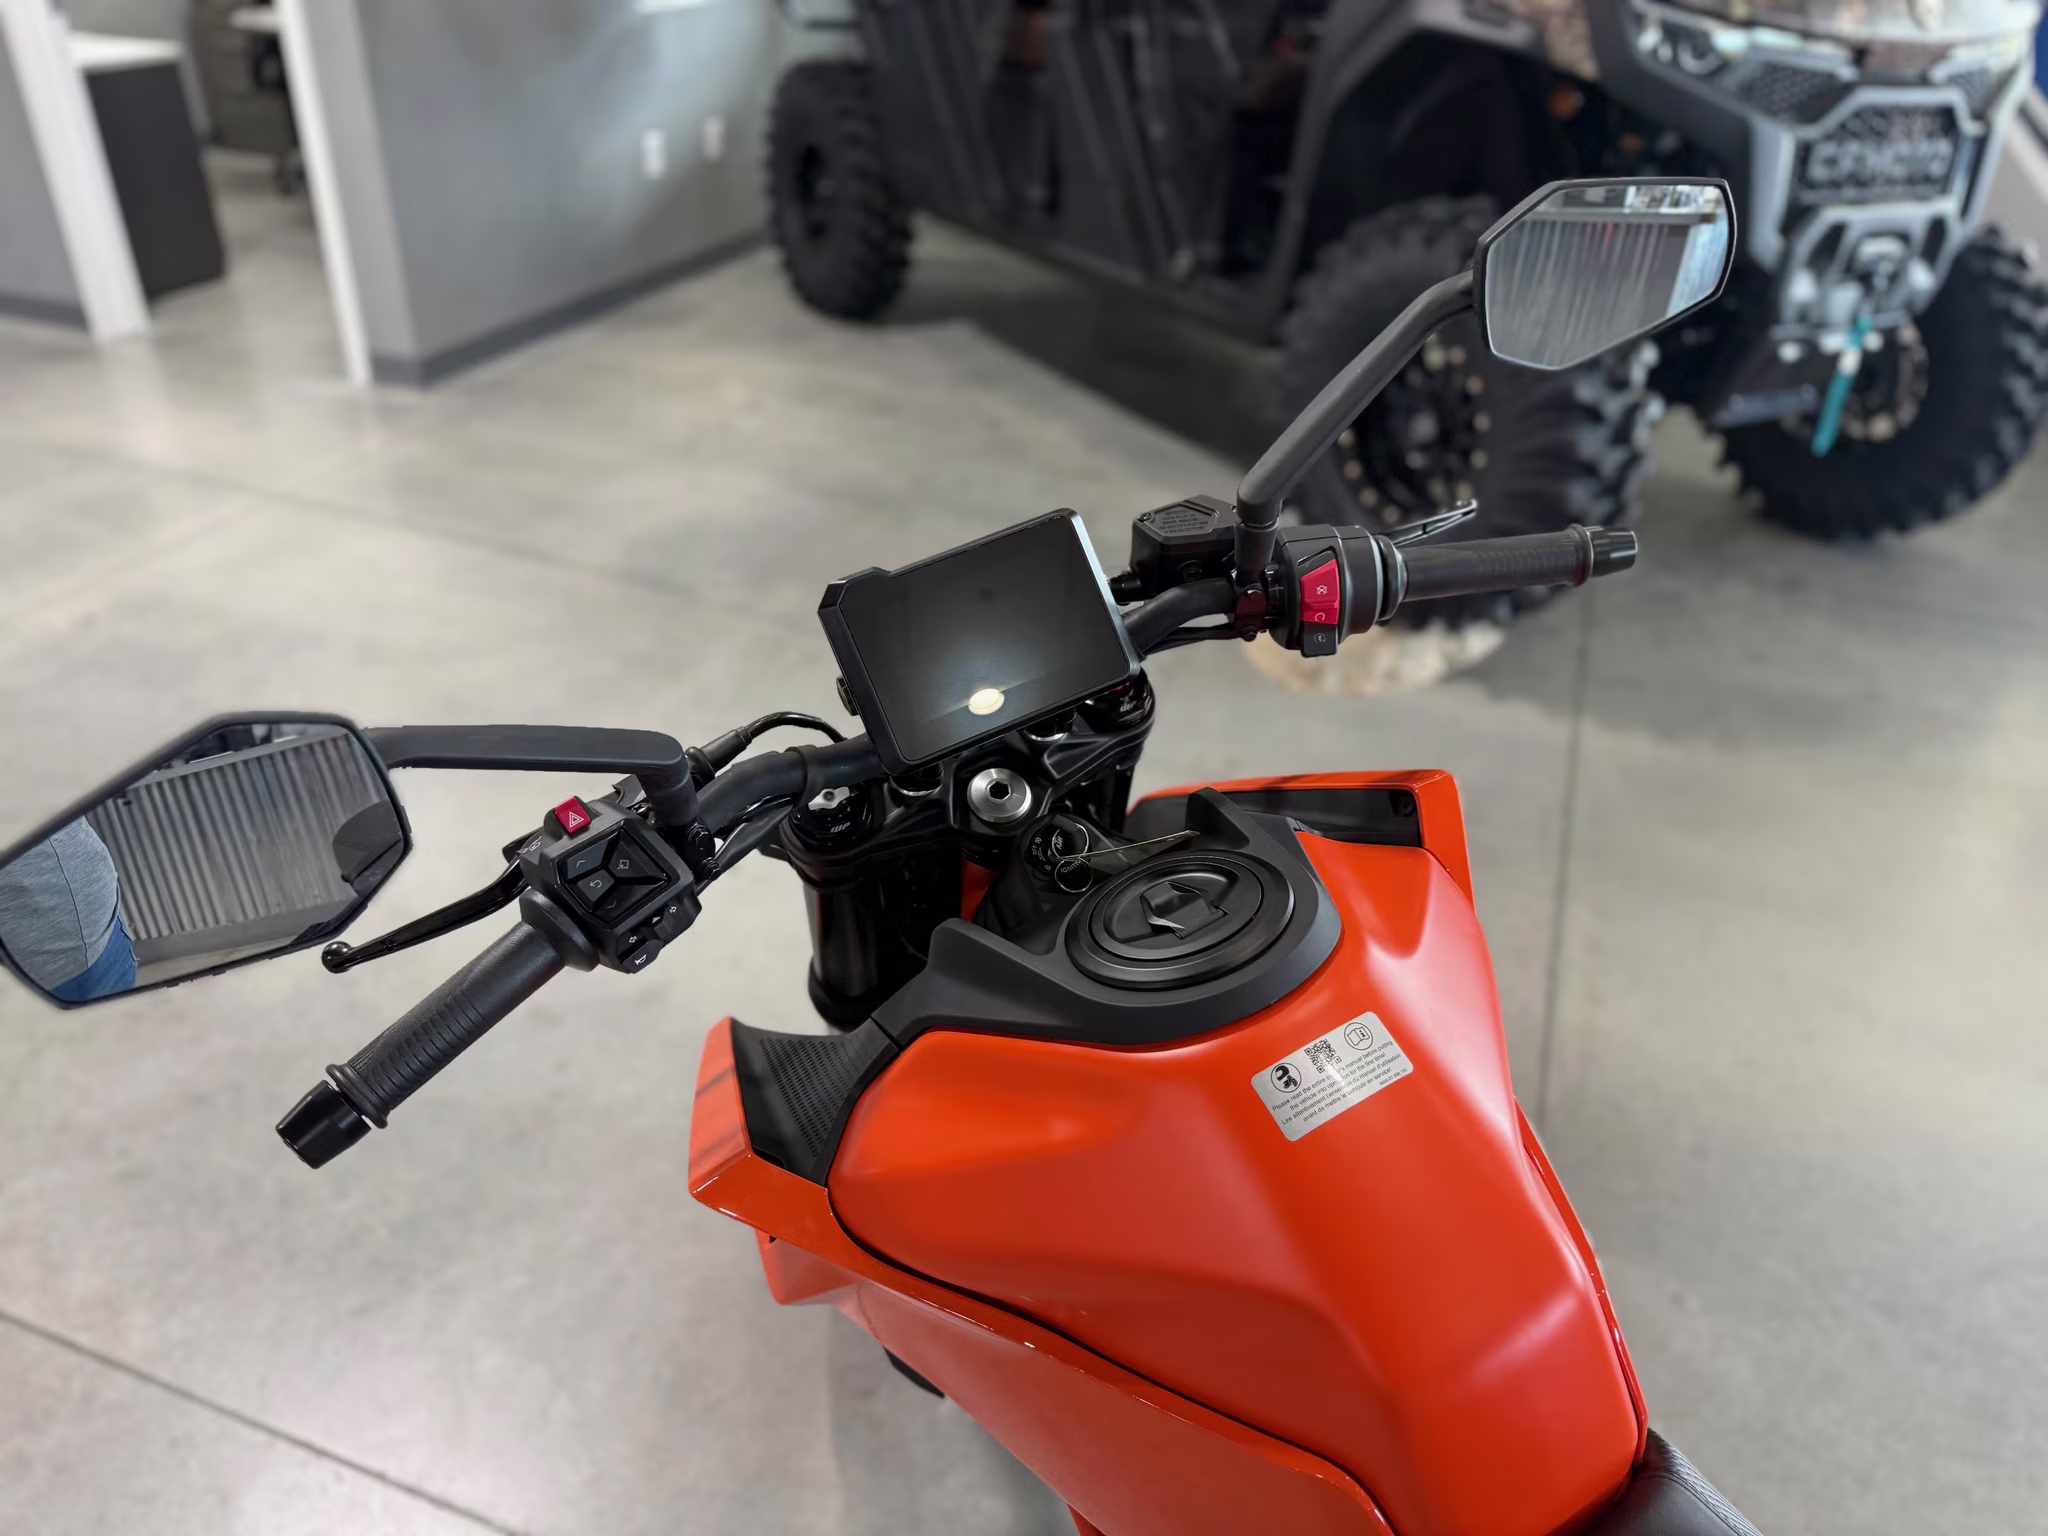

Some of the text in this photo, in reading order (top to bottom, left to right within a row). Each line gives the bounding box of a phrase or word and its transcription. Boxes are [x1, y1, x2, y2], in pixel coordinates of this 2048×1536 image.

[1054, 835, 1064, 850] KTM
[1060, 859, 1082, 873] IGNITIO
[1272, 1098, 1290, 1111] Please
[1290, 1091, 1302, 1100] read
[1311, 1077, 1326, 1088] entire
[1344, 1056, 1362, 1068] manual
[1362, 1048, 1377, 1059] before
[1377, 1040, 1393, 1052] putting
[1298, 1092, 1317, 1105] vehicle
[1316, 1086, 1327, 1094] into
[1326, 1073, 1350, 1089] opeon
[1364, 1058, 1374, 1066] first
[1281, 1116, 1293, 1125] Lire
[1358, 1067, 1376, 1079] manuel
[1302, 1109, 1318, 1121] avant
[1324, 1095, 1341, 1108] mettre
